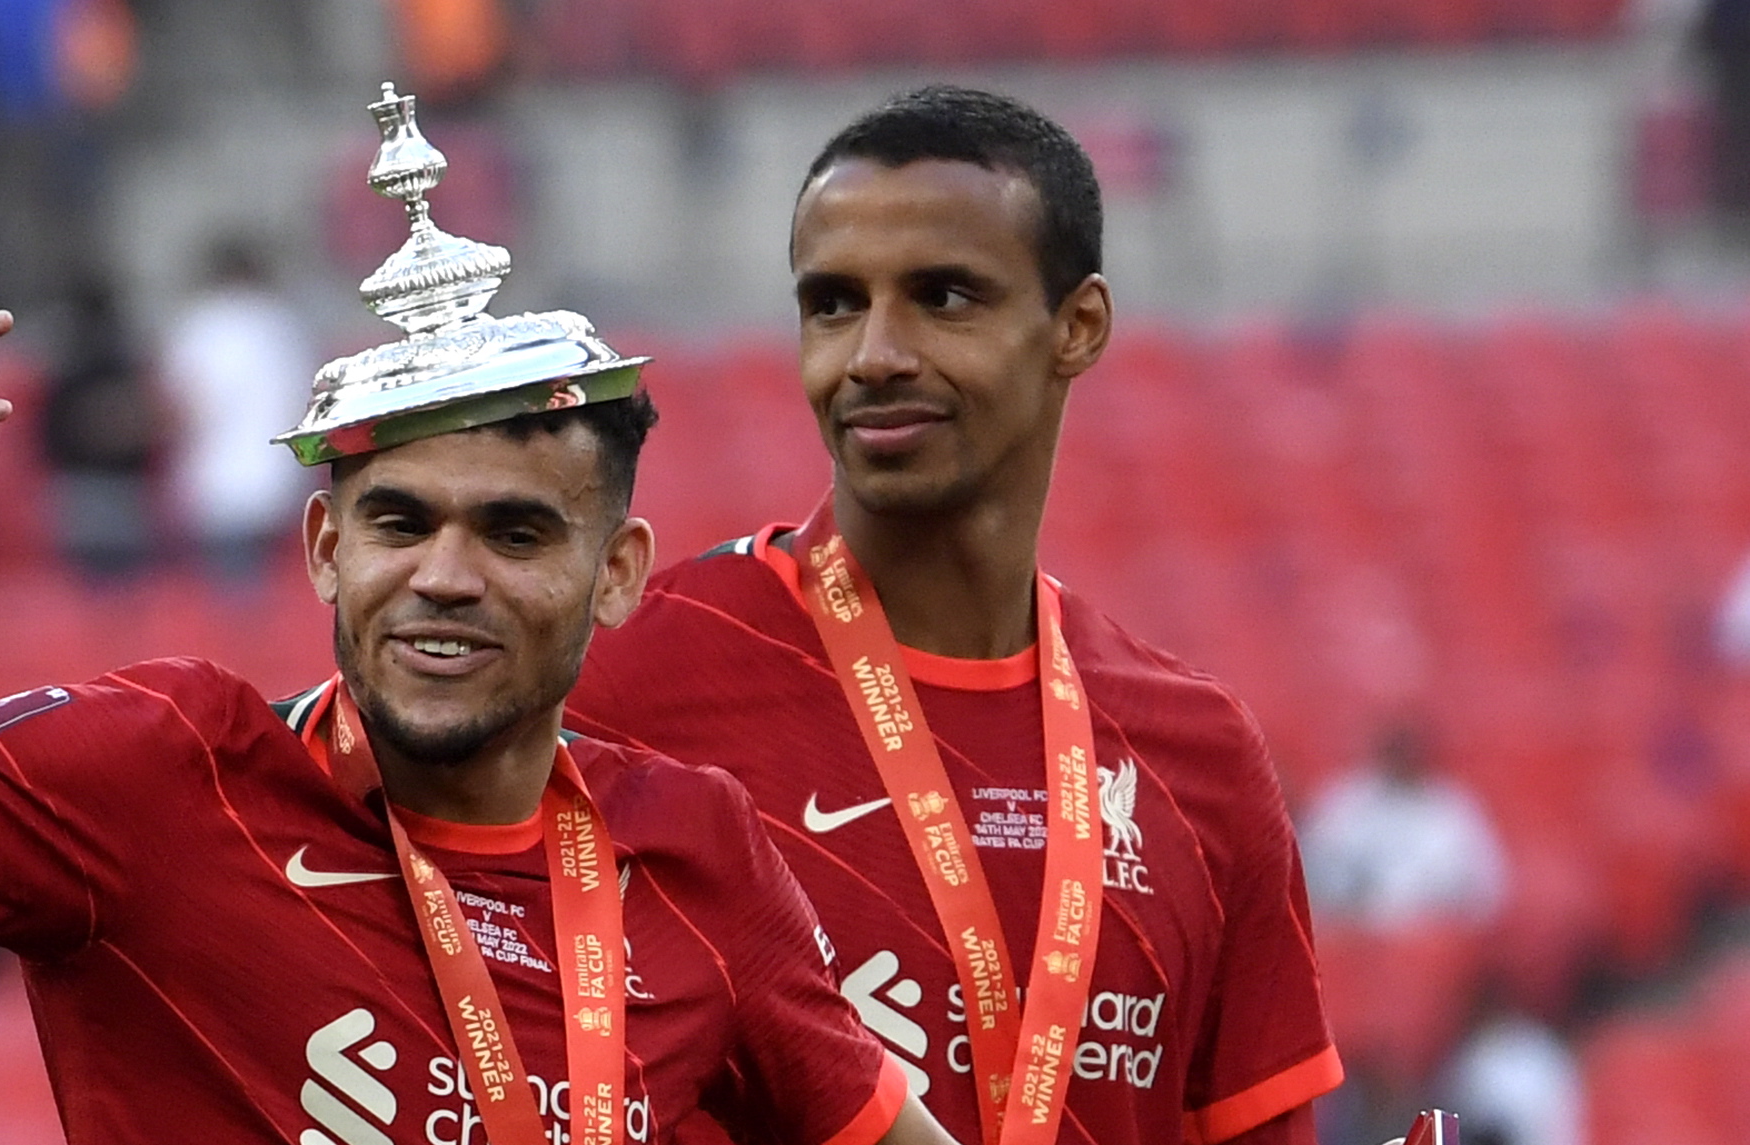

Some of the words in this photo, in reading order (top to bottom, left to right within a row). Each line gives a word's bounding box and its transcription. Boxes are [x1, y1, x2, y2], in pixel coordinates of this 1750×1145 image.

[820, 566, 836, 590] FA
[827, 587, 852, 623] CUP
[852, 656, 903, 752] WINNER
[875, 664, 914, 732] 2021-22
[972, 787, 1032, 800] LIVERPOOL
[980, 812, 1027, 825] CHELSEA
[1058, 753, 1074, 822] 2021-22
[1071, 745, 1091, 840] WINNER
[558, 812, 577, 878] 2021-22
[574, 794, 600, 892] WINNER
[924, 825, 943, 849] FA
[935, 848, 959, 887] CUP
[938, 821, 970, 885] Emirates
[1028, 826, 1048, 838] 202
[424, 891, 439, 915] FA
[434, 916, 455, 956] CUP
[432, 889, 463, 954] Emirates
[456, 891, 508, 914] IVERPOOL
[510, 904, 525, 918] FC
[482, 910, 492, 922] V
[1054, 878, 1072, 941] Emirates
[1071, 881, 1086, 921] CUP
[495, 950, 518, 964] CUP
[502, 928, 517, 941] FC
[574, 934, 591, 996] Emirates
[587, 934, 605, 974] CUP
[1067, 922, 1082, 946] FA
[591, 975, 606, 998] FA
[961, 926, 995, 1030] WINNER
[981, 939, 1008, 1012] 2021-22
[458, 995, 505, 1102] WINNER
[478, 1008, 514, 1083] 2021-22
[1021, 1034, 1046, 1106] 2021-22
[1032, 1024, 1066, 1124] WINNER
